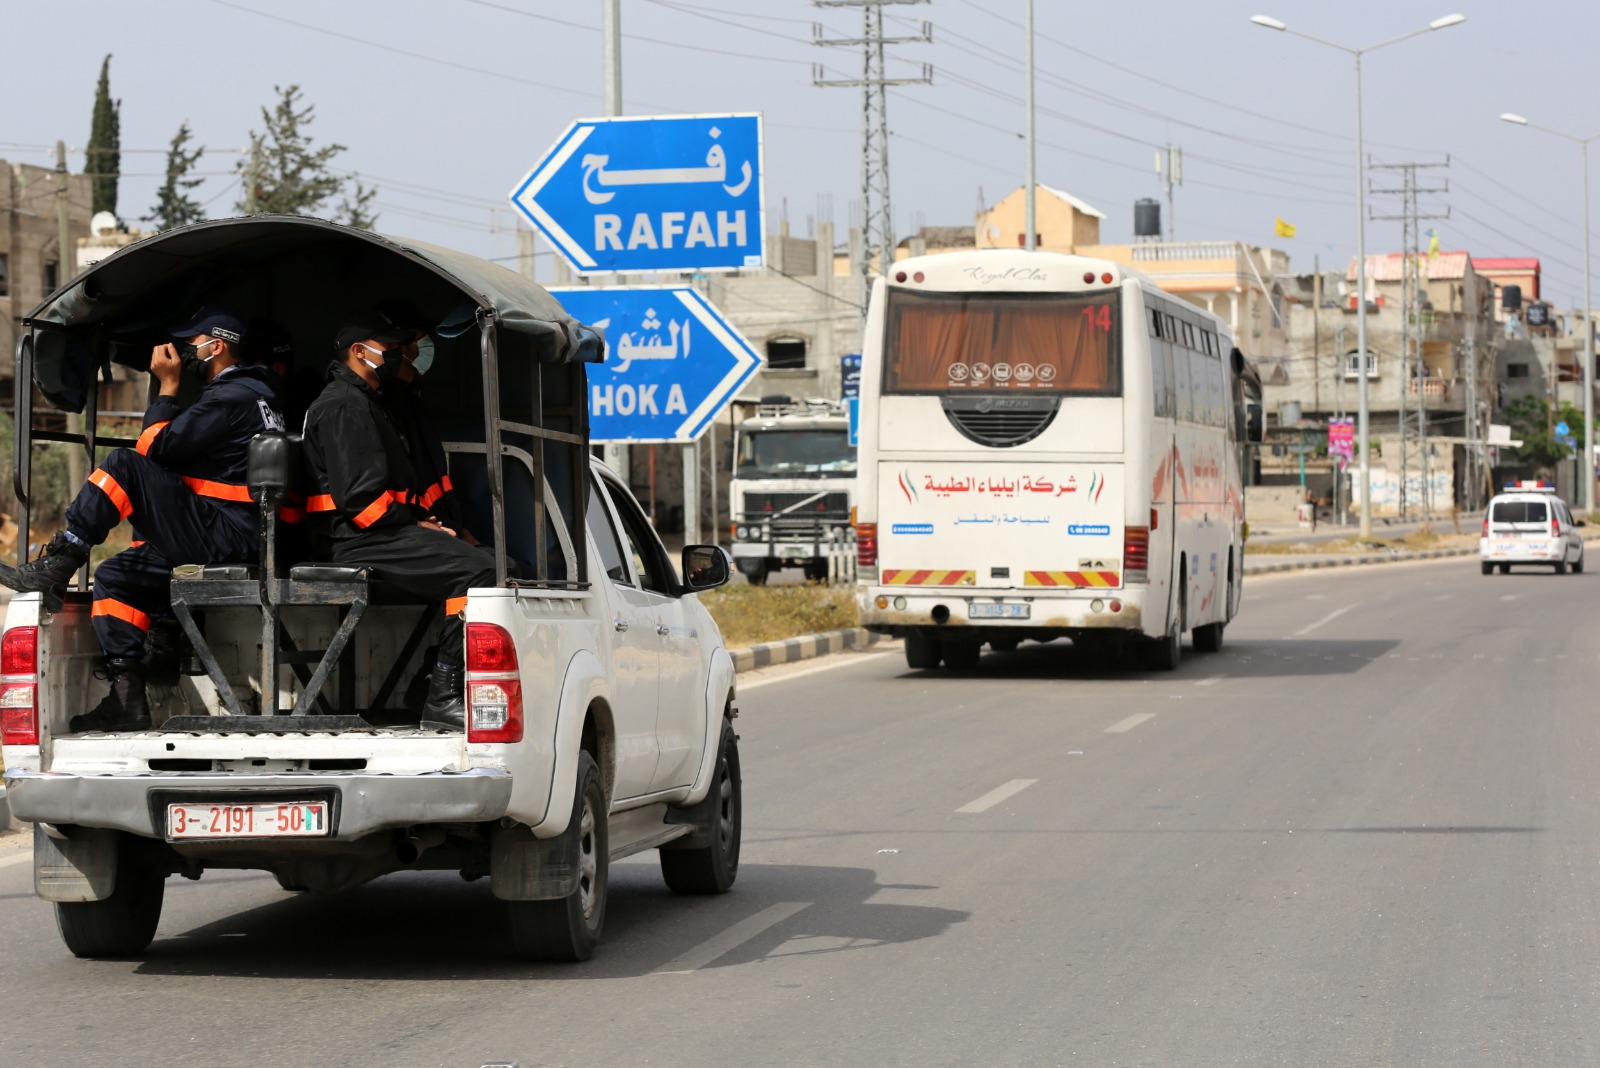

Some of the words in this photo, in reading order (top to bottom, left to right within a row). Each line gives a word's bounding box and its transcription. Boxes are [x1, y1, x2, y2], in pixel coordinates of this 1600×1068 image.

[581, 126, 753, 204] رفح
[594, 209, 748, 251] RAFAH
[963, 266, 1015, 285] Royal
[1082, 303, 1112, 332] 14
[587, 383, 688, 417] HOKA
[924, 474, 976, 497] الطيبة
[1023, 475, 1077, 497] شركة
